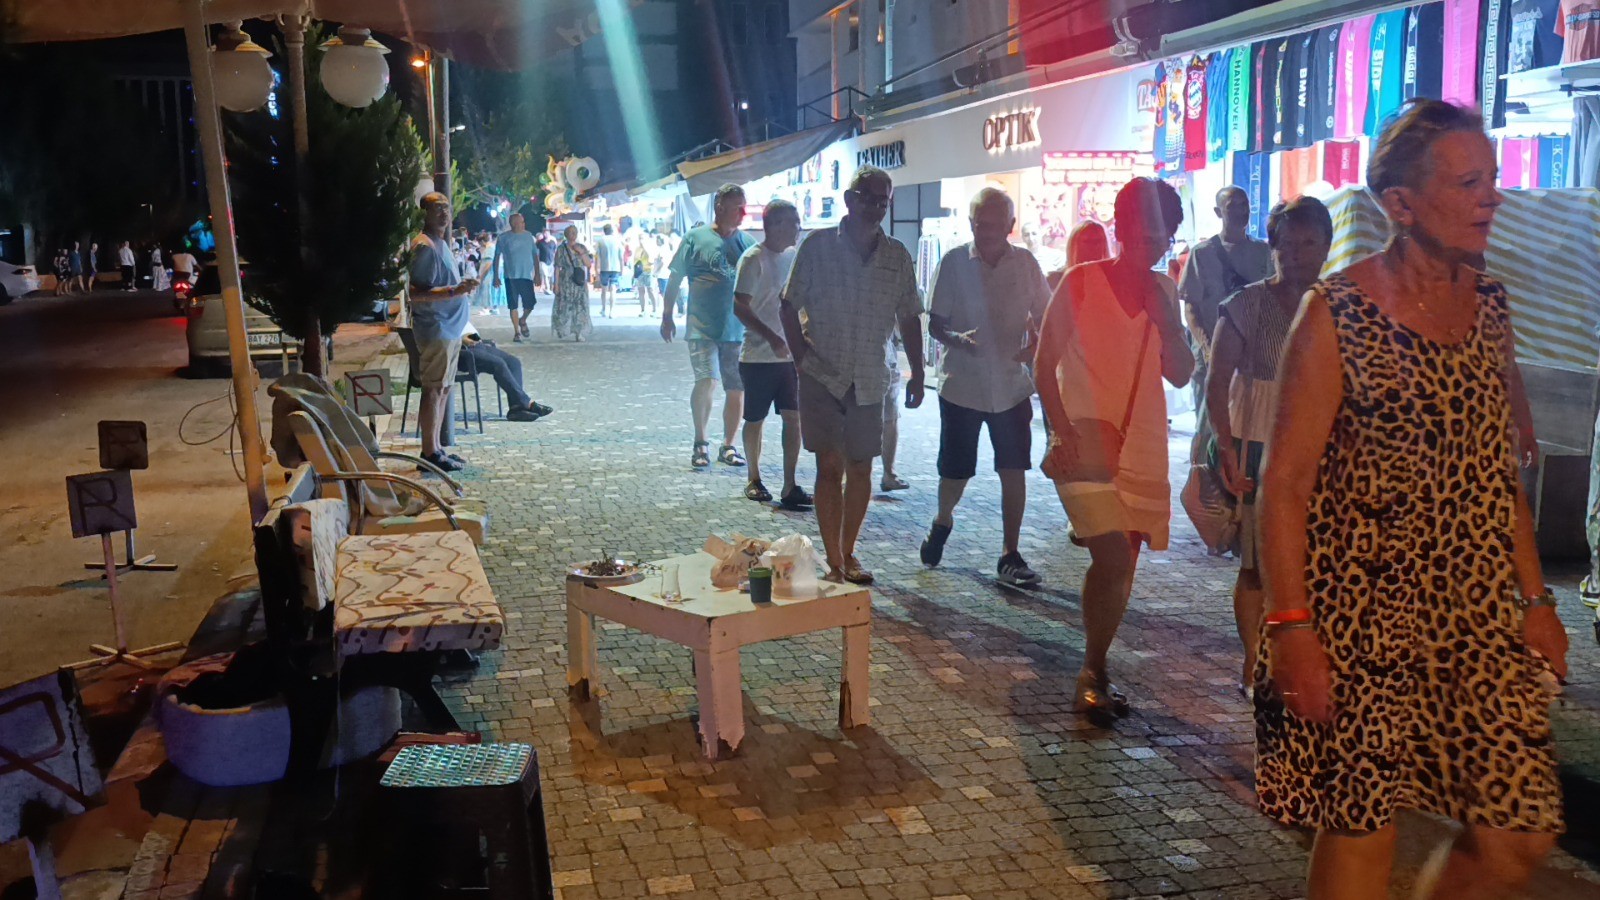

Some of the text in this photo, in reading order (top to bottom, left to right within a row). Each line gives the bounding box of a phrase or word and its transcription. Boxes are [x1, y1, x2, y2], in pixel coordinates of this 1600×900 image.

[1232, 59, 1242, 131] HANNOVER
[1298, 68, 1308, 107] BMW
[983, 110, 1038, 151] OPTIK
